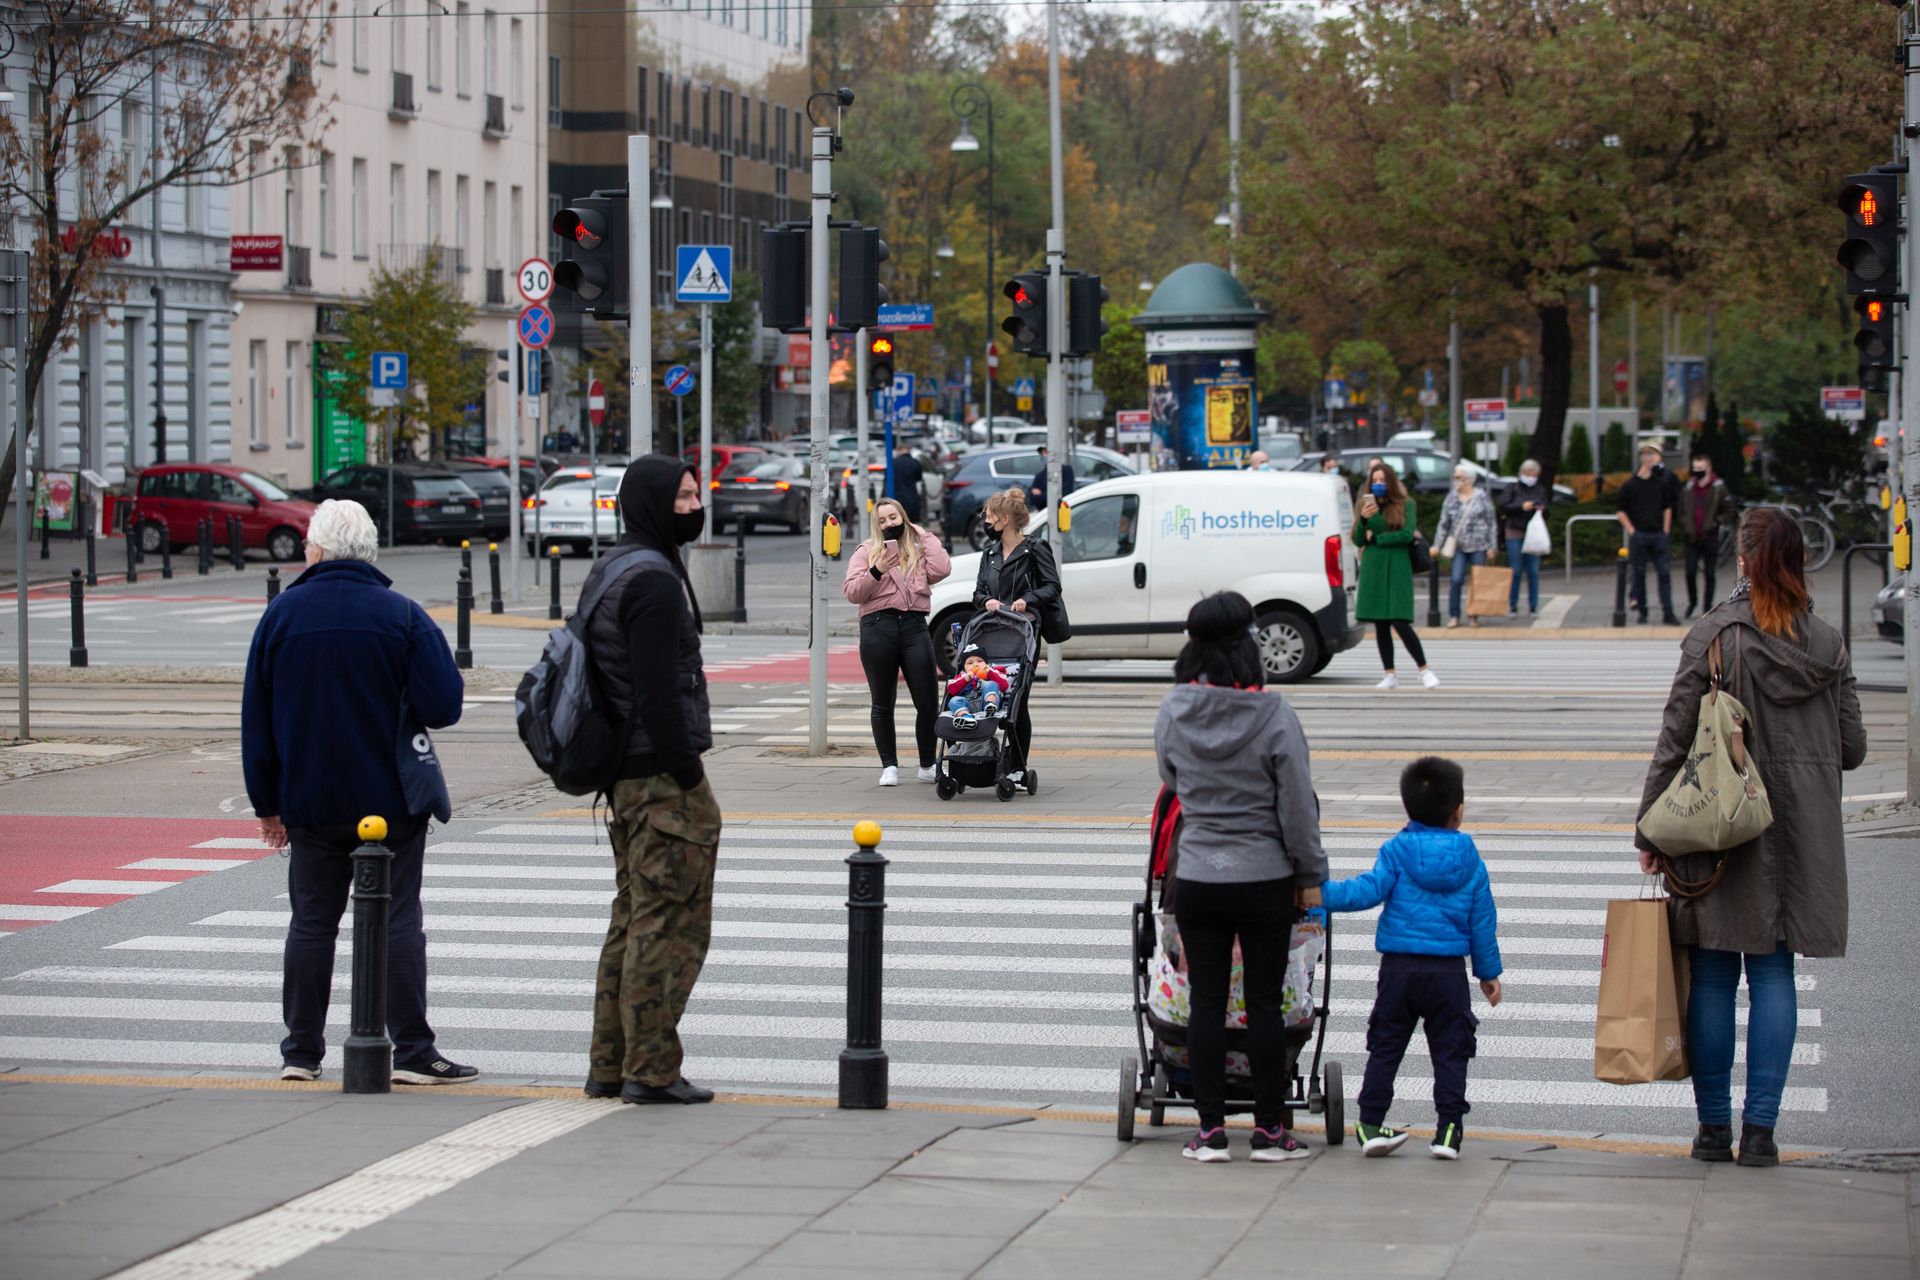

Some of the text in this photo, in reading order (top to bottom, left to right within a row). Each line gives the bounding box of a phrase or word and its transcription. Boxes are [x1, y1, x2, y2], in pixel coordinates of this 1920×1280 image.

[232, 239, 279, 250] VAPIANO
[523, 270, 549, 292] 30
[878, 311, 927, 324] rozolimskie
[379, 356, 401, 385] P
[1202, 510, 1319, 530] hosthelper
